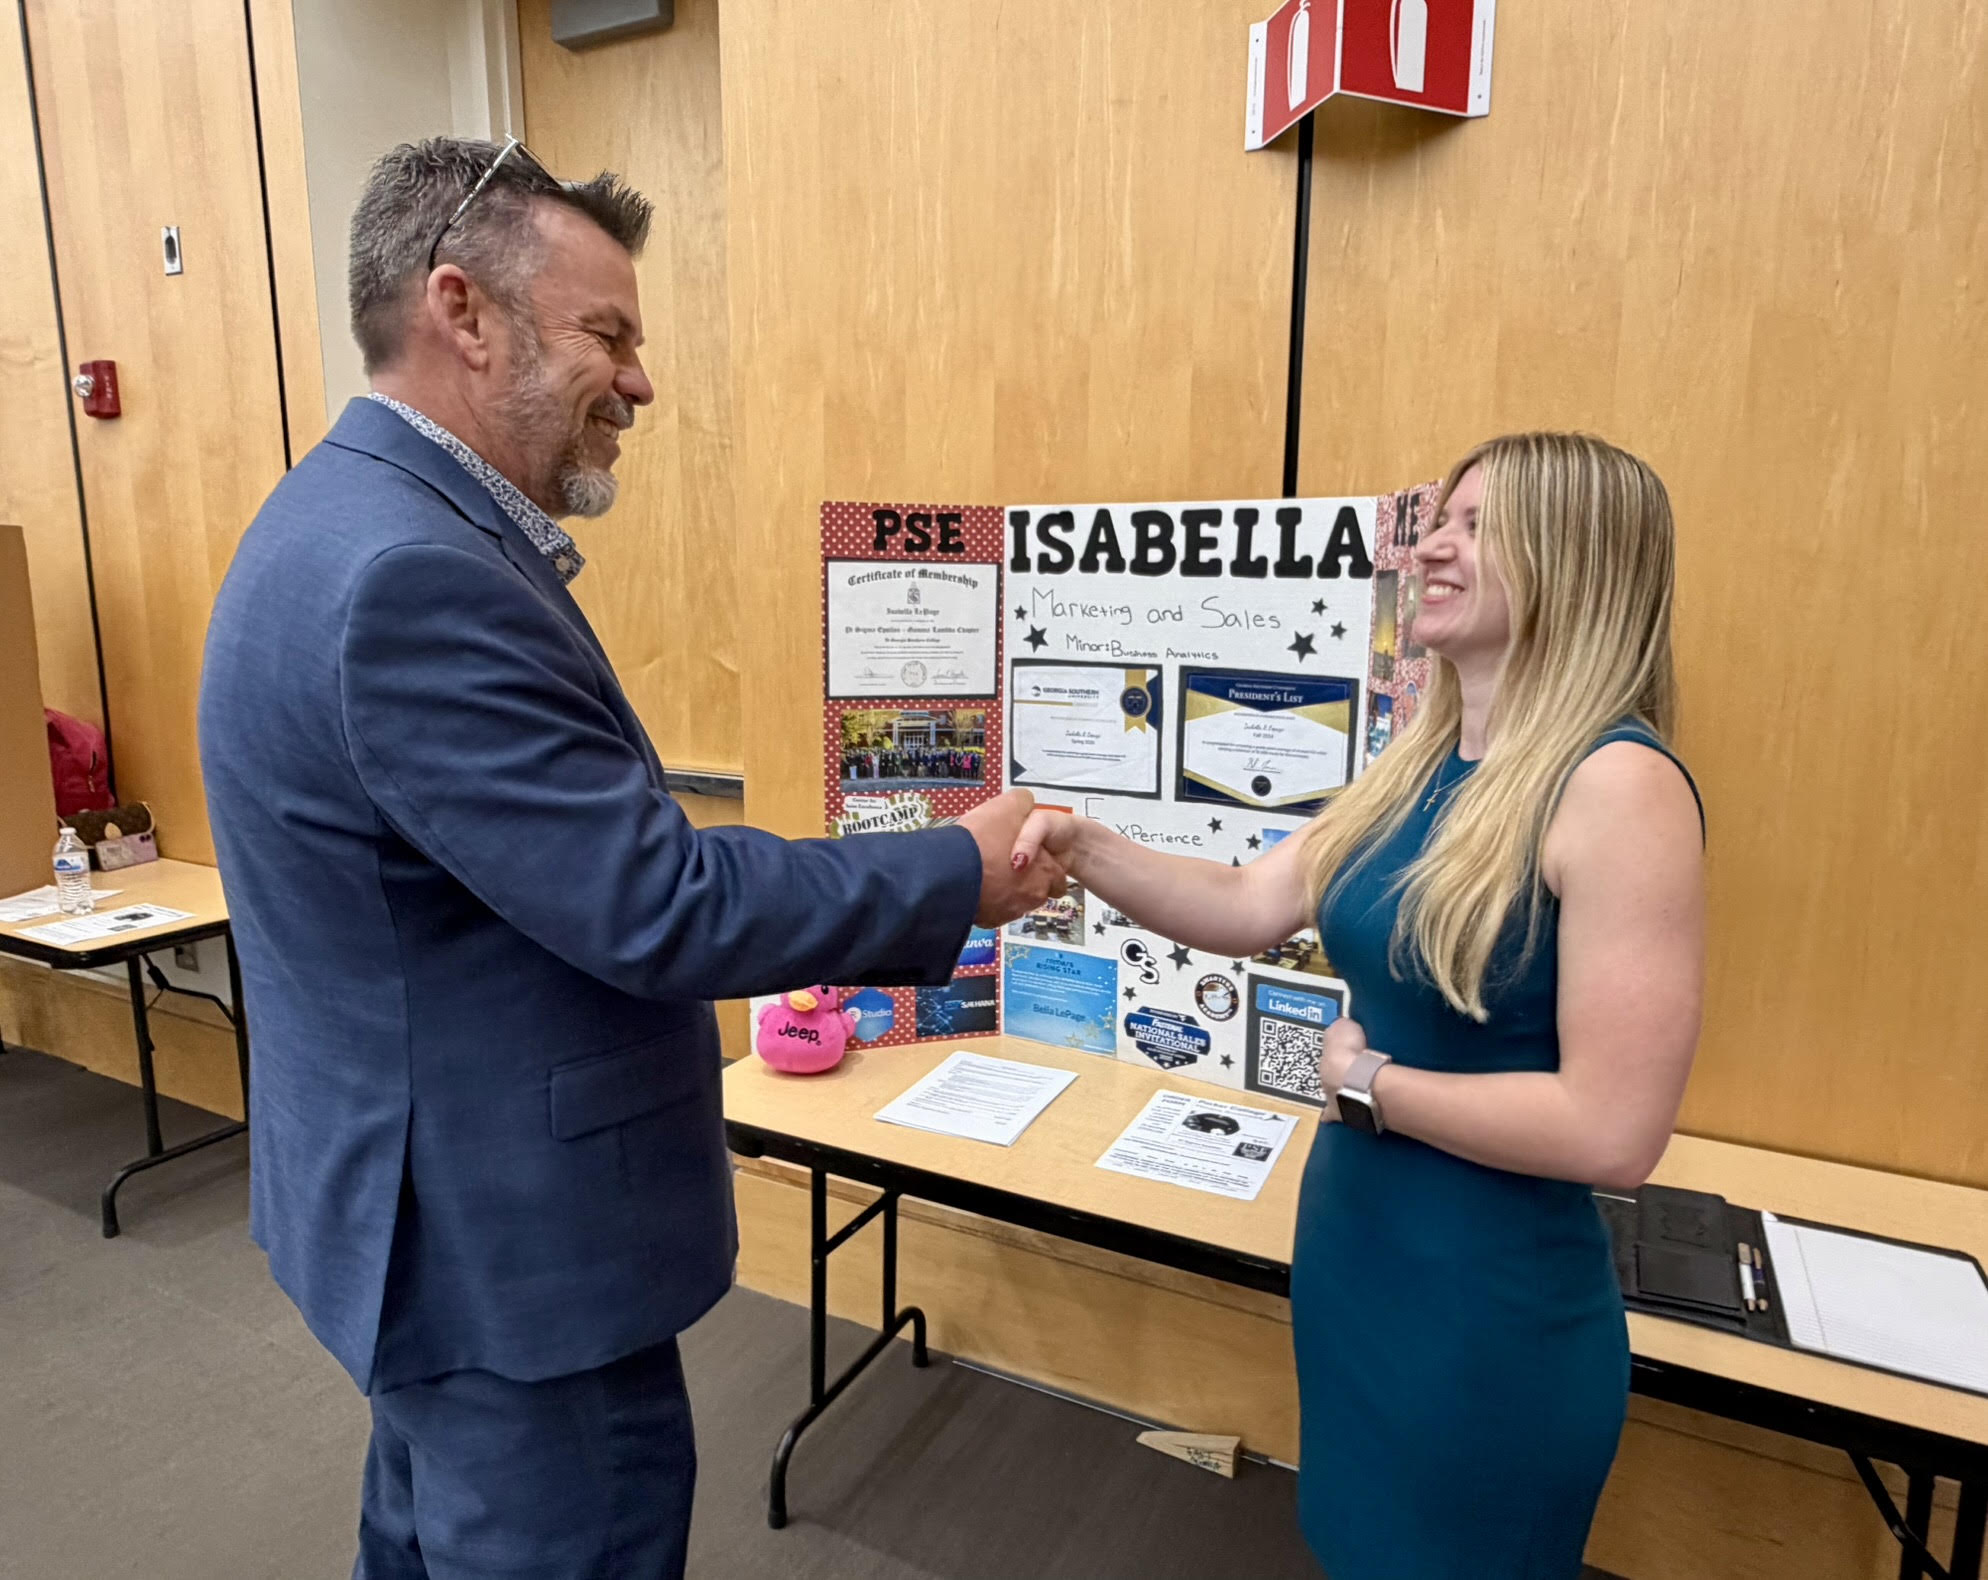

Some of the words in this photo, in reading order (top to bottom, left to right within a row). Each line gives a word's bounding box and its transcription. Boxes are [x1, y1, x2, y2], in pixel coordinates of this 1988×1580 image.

[873, 509, 965, 553] PSE
[1009, 506, 1374, 579] ISABELLA
[848, 569, 902, 586] Certificate
[905, 568, 915, 578] of
[918, 569, 978, 590] Membership
[1033, 587, 1132, 626] Marketing
[1147, 605, 1183, 623] and
[1201, 596, 1281, 630] Sales
[842, 807, 918, 835] BOOTCAMP
[963, 938, 994, 949] anva
[861, 1008, 892, 1018] Studio
[1033, 1003, 1055, 1016] Bella
[778, 1021, 819, 1043] Jeep
[1130, 1022, 1177, 1040] NATIONAL
[1177, 1033, 1206, 1047] SALES
[1135, 1031, 1201, 1053] INVITATIONAL
